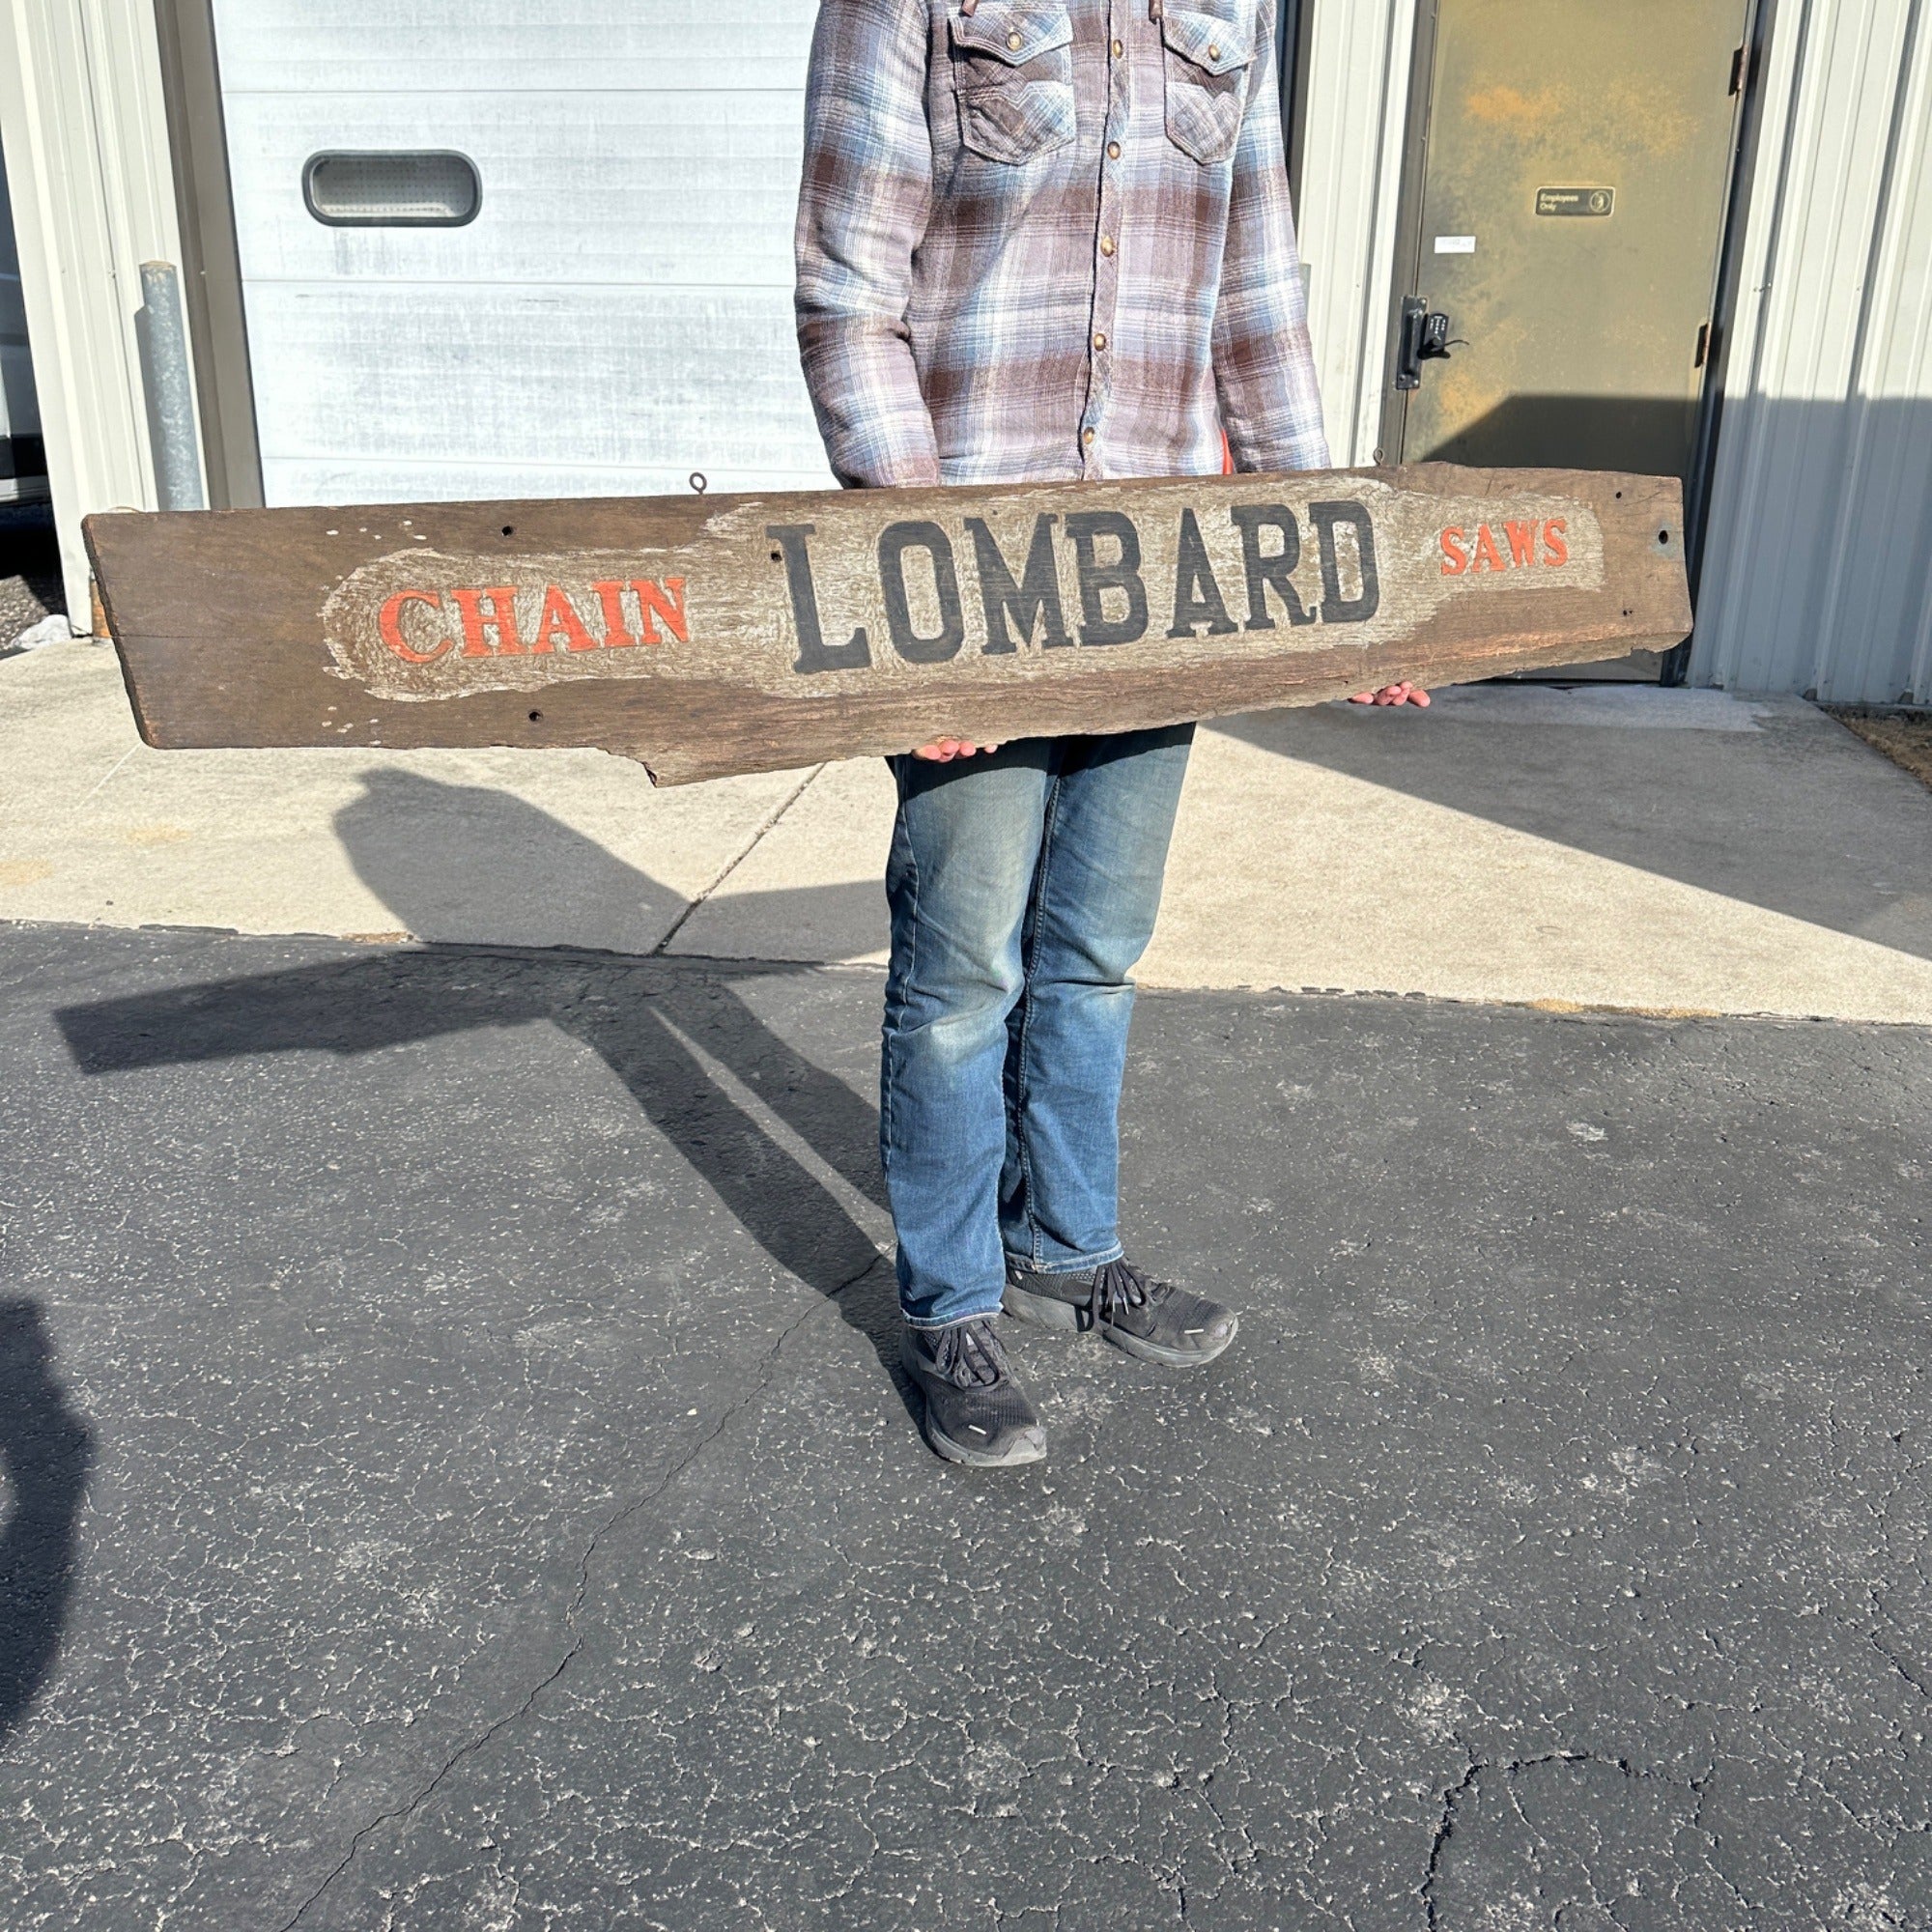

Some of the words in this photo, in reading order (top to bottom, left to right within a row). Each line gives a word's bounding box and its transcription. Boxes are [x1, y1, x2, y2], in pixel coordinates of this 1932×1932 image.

[1540, 193, 1578, 203] Employees
[1539, 202, 1557, 212] Only
[379, 577, 689, 663] CHAIN
[766, 499, 1379, 673] LOMBARD
[1440, 518, 1569, 575] SAWS
